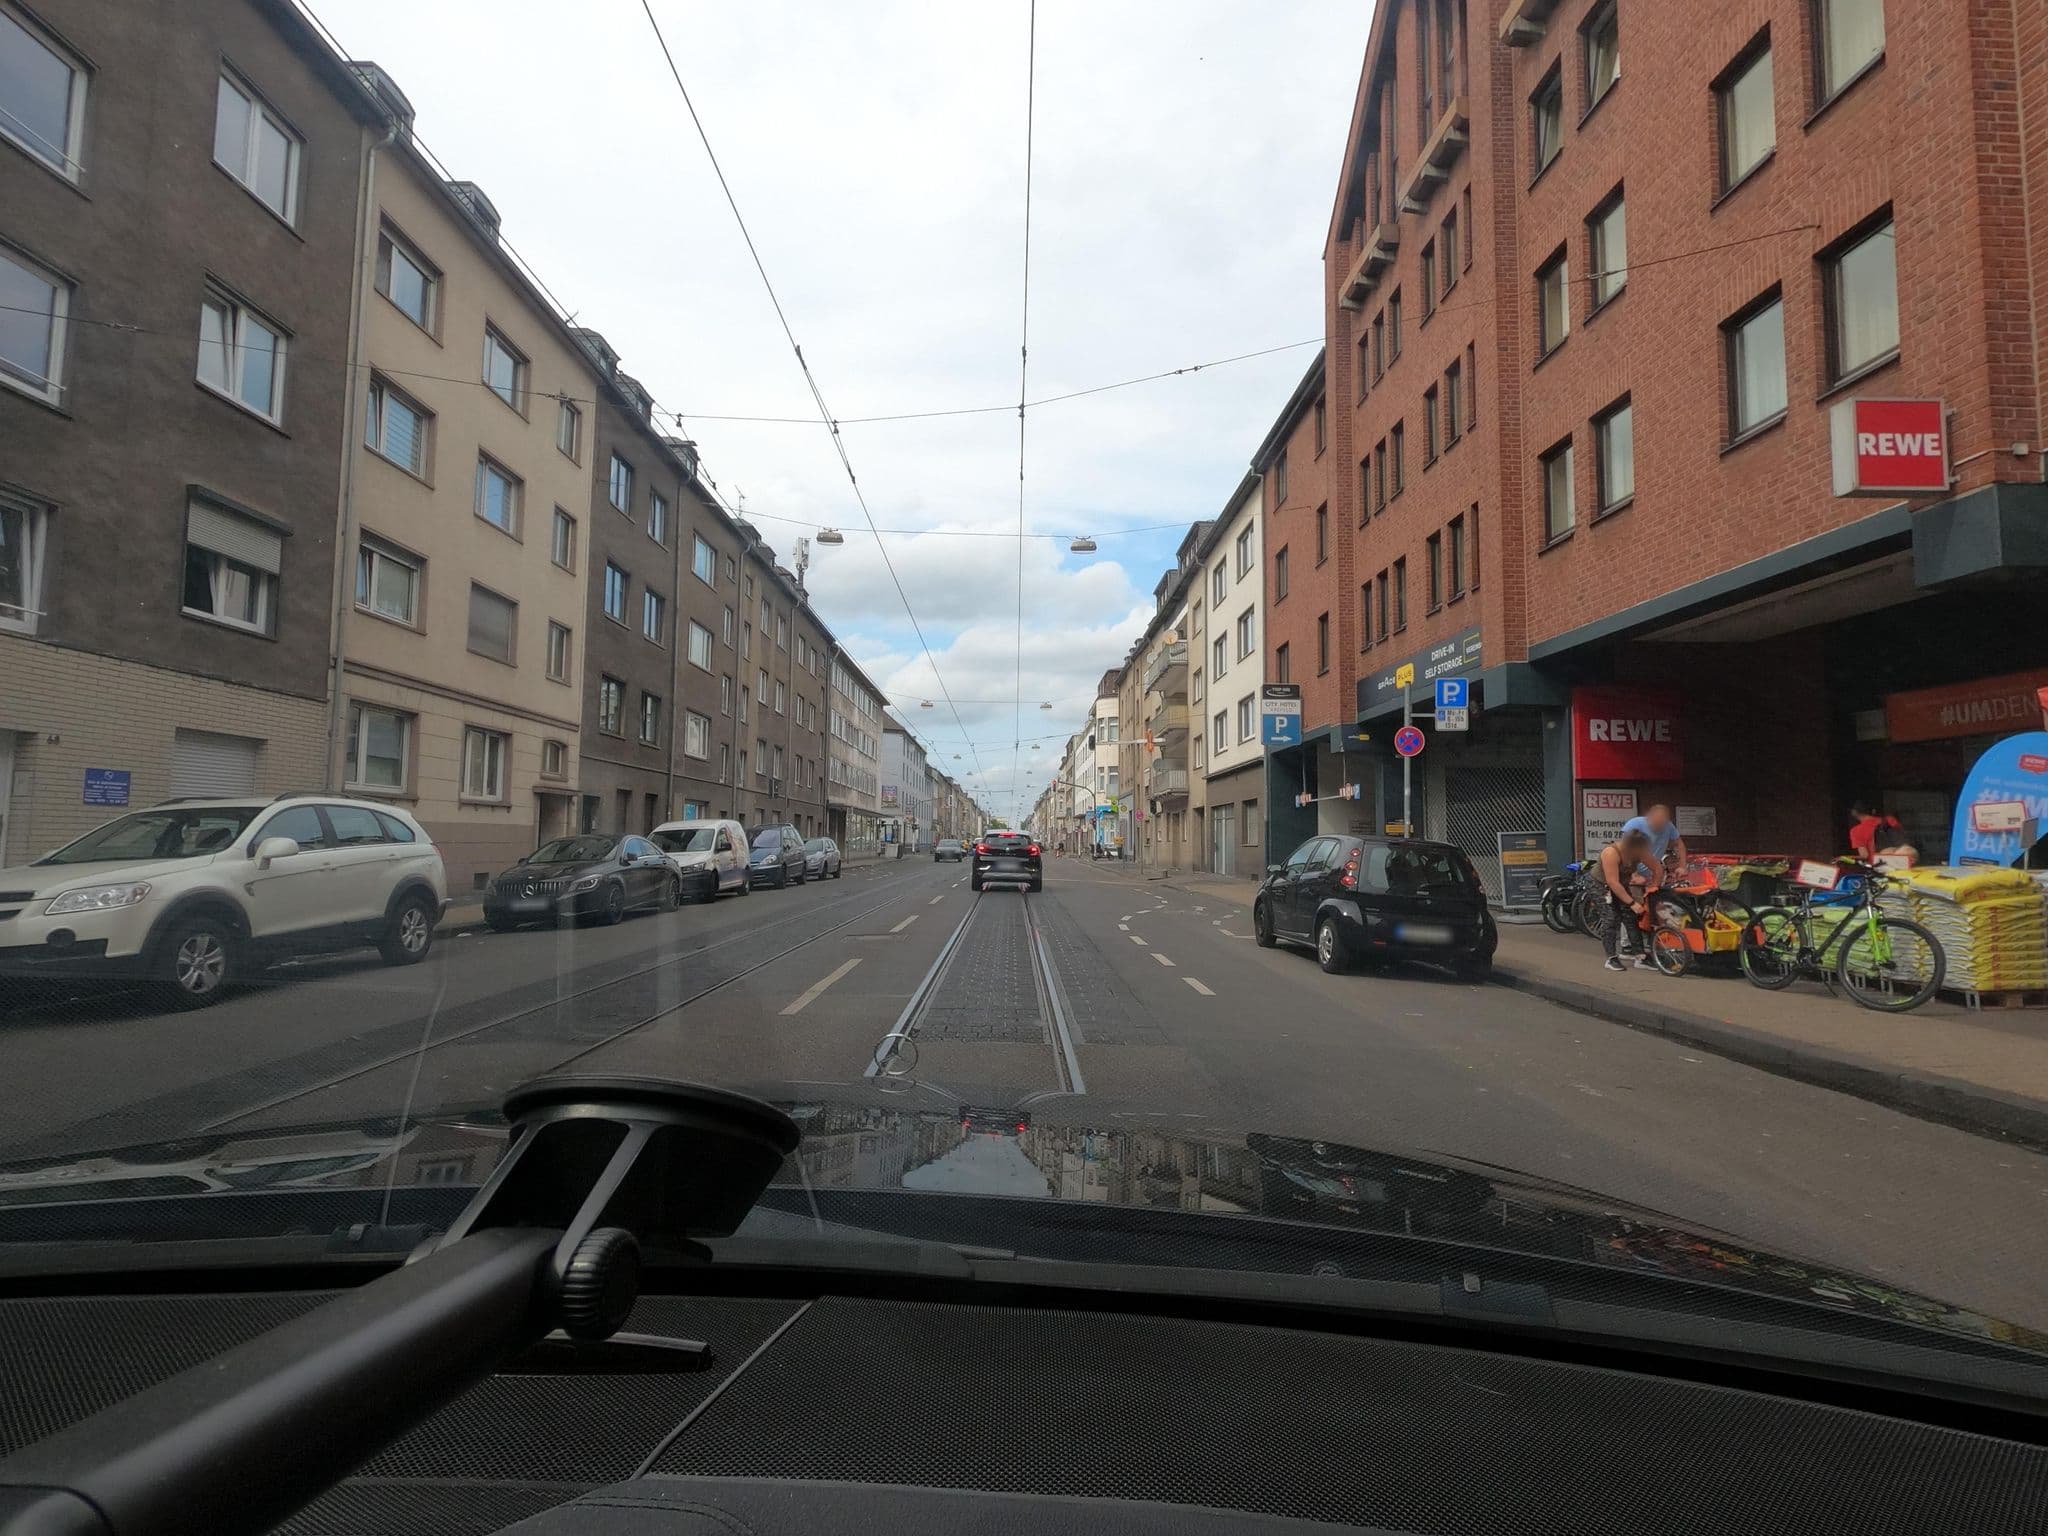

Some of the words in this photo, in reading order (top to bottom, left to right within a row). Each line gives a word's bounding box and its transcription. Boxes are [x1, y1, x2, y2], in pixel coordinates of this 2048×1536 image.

[1858, 432, 1941, 456] REWE
[1431, 642, 1455, 662] DRIVE-IN
[1437, 655, 1463, 676] STORAGE
[1443, 682, 1460, 704] P
[1275, 717, 1288, 734] P
[1590, 719, 1672, 741] REWE
[1587, 794, 1632, 807] REWE
[1586, 819, 1625, 828] Lieferserv
